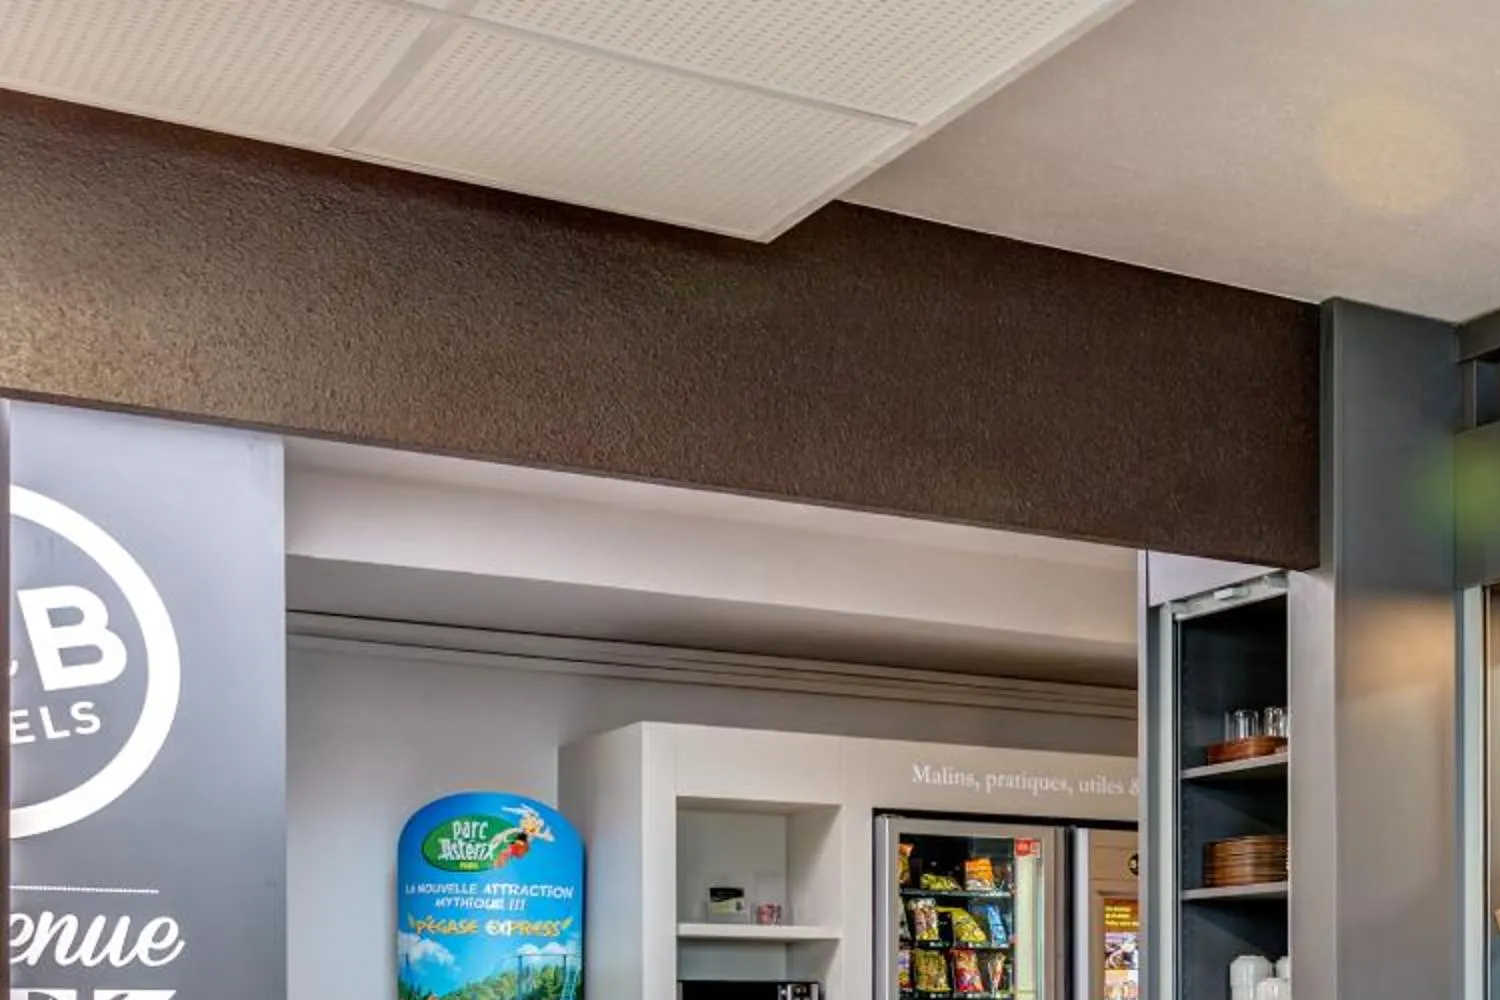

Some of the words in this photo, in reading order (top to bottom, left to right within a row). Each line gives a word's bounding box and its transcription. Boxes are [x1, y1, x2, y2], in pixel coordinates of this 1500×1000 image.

[912, 763, 980, 791] Malins,
[985, 770, 1073, 795] pratiques,
[1079, 775, 1123, 794] utiles
[418, 883, 477, 895] NOUVELLE
[483, 883, 575, 899] ATTRACTION
[436, 897, 504, 910] MYTHIQUE
